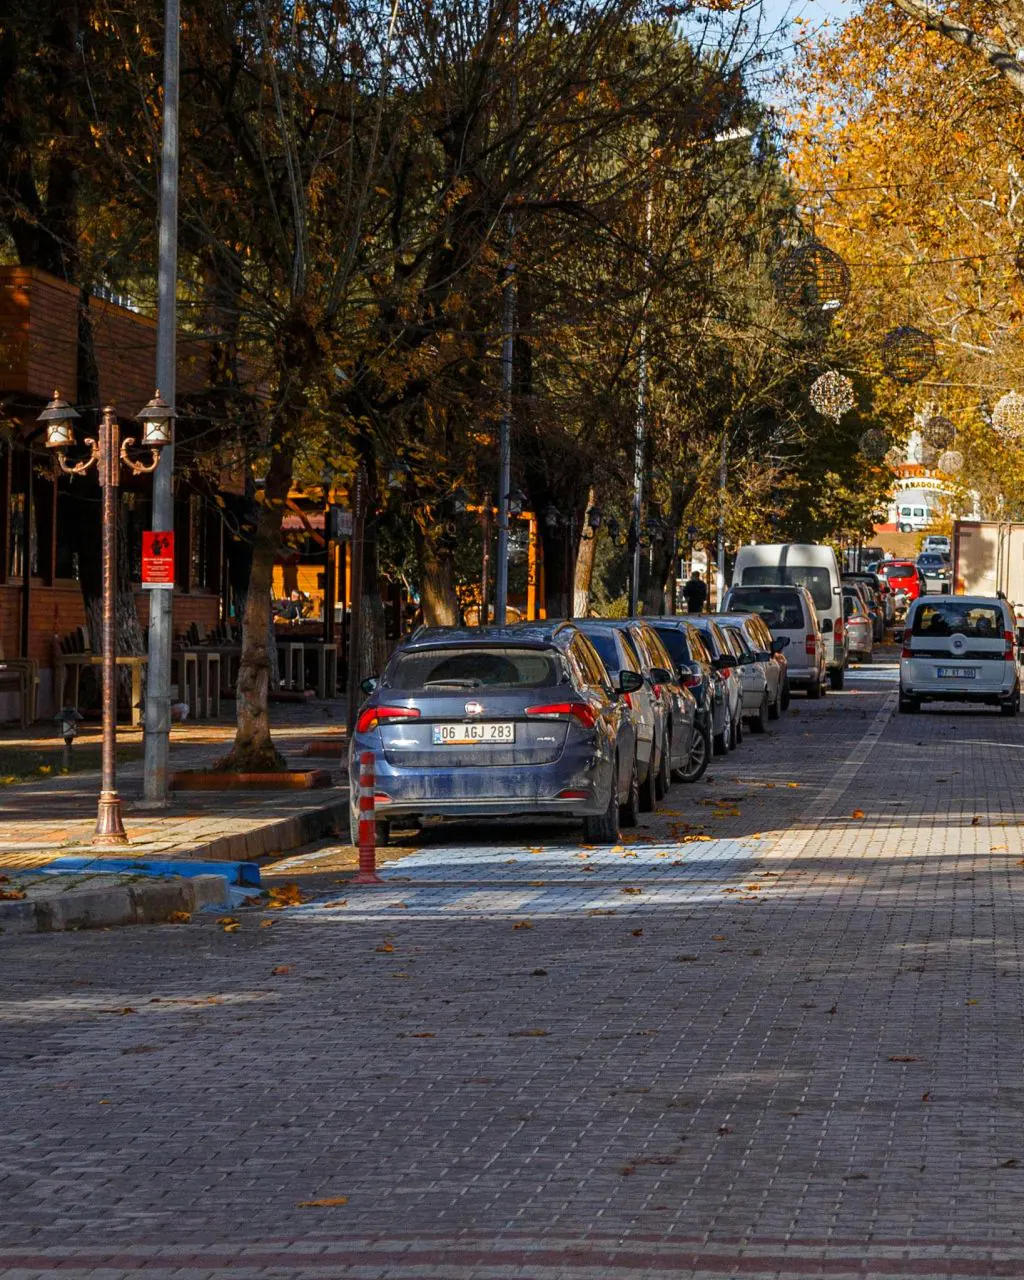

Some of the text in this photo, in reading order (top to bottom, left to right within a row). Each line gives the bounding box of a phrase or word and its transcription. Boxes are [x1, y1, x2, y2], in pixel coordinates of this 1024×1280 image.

[441, 725, 512, 739] 06 AGJ 283
